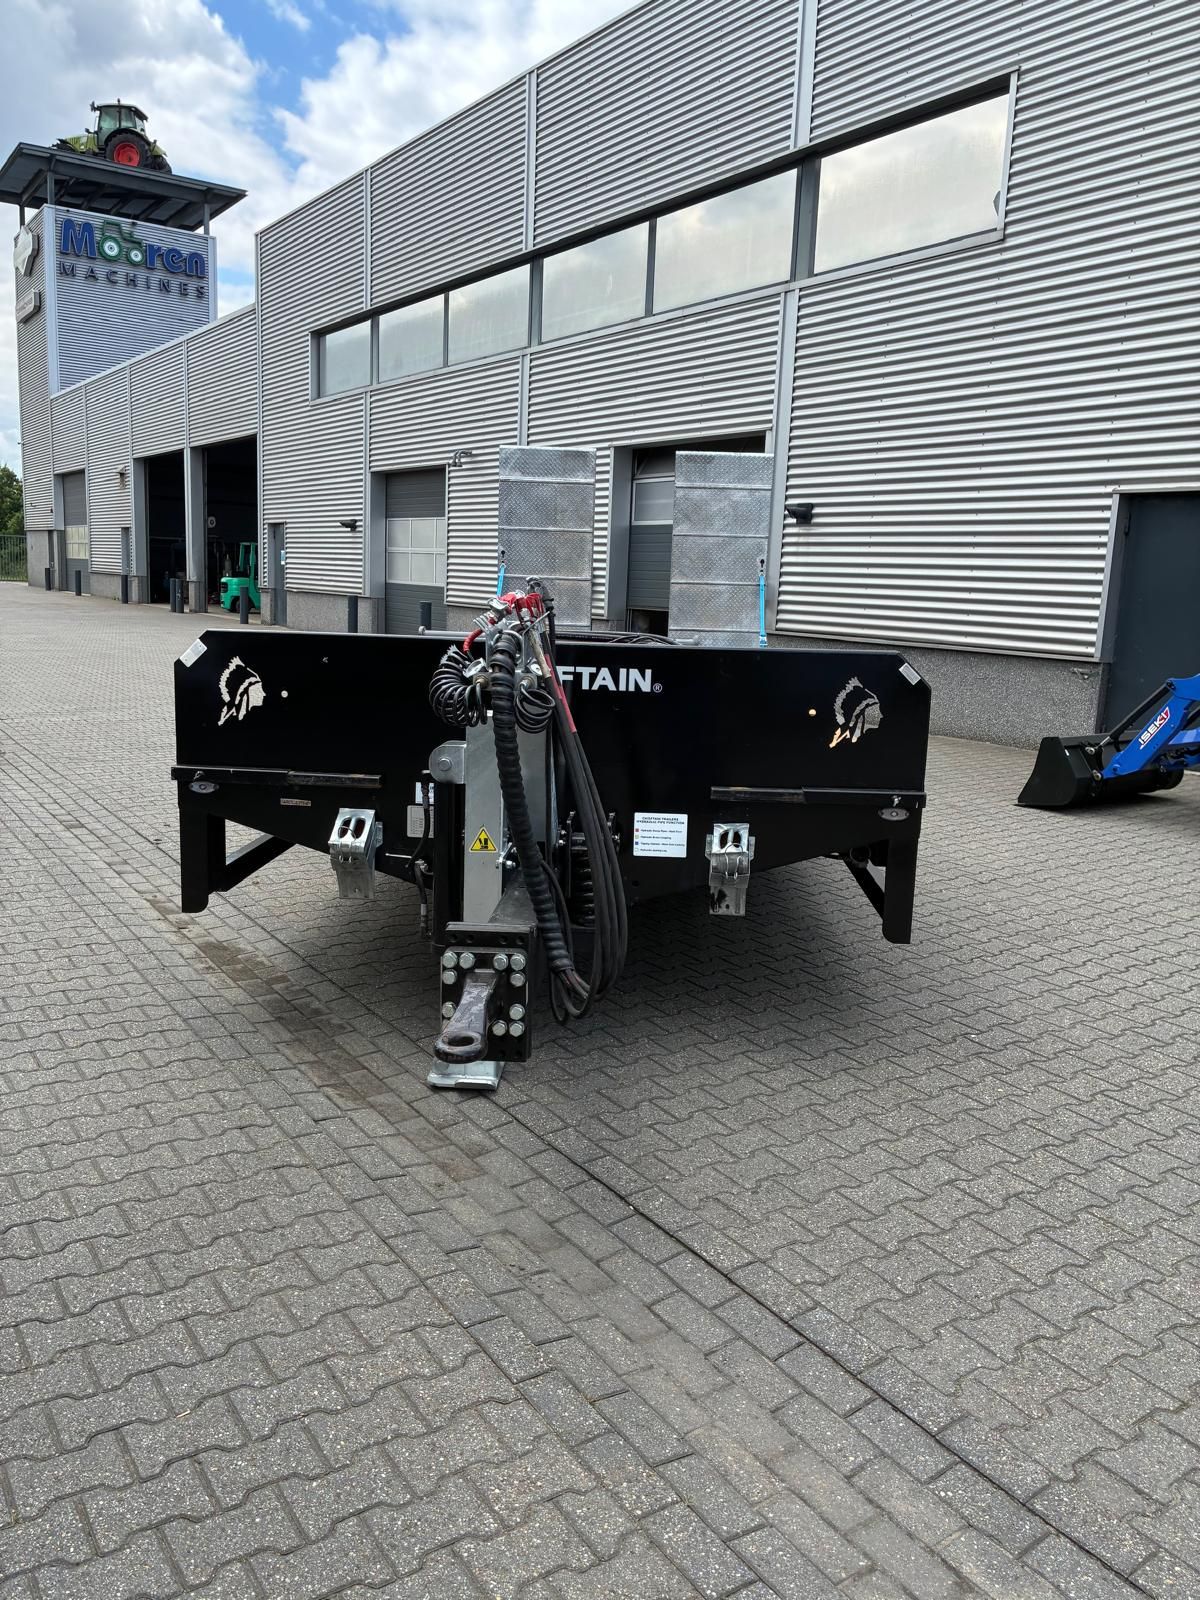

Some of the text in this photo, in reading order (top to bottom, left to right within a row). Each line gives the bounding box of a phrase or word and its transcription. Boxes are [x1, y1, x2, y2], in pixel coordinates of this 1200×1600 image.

[60, 218, 206, 278] Mooren
[60, 261, 206, 298] MACHINES
[1137, 711, 1169, 747] ISEKI
